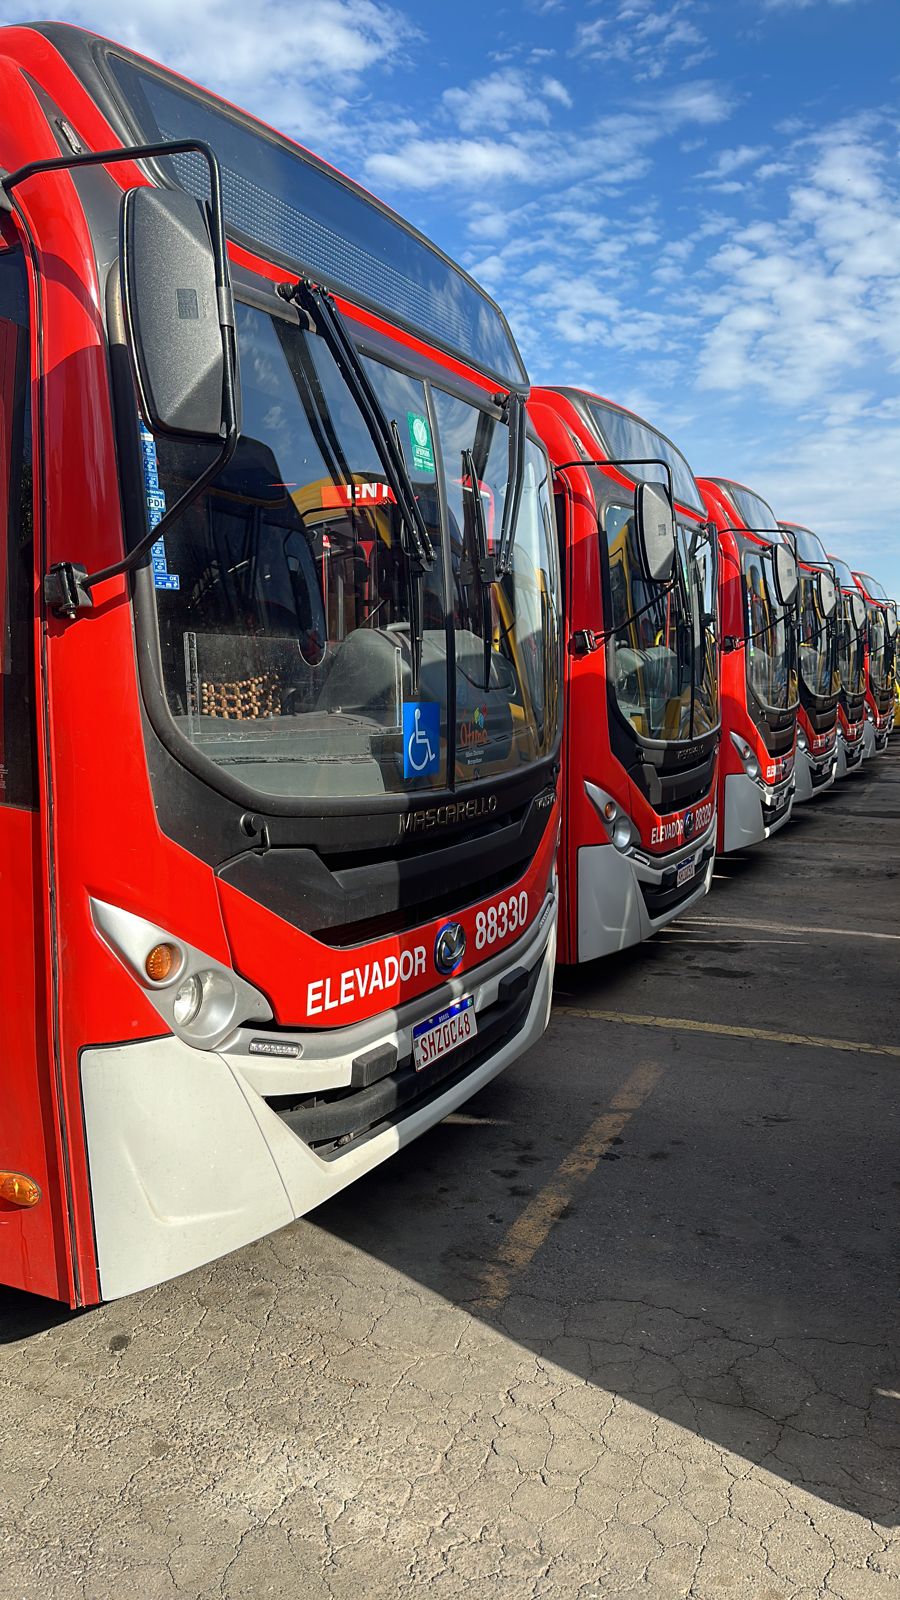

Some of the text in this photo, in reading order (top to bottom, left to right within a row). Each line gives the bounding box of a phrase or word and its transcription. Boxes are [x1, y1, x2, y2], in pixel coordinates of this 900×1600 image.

[148, 498, 163, 508] PDI
[399, 794, 498, 835] MASCARELLO
[651, 819, 685, 845] ELEVADOR
[474, 890, 529, 951] 88330
[306, 945, 427, 1017] ELEVADOR
